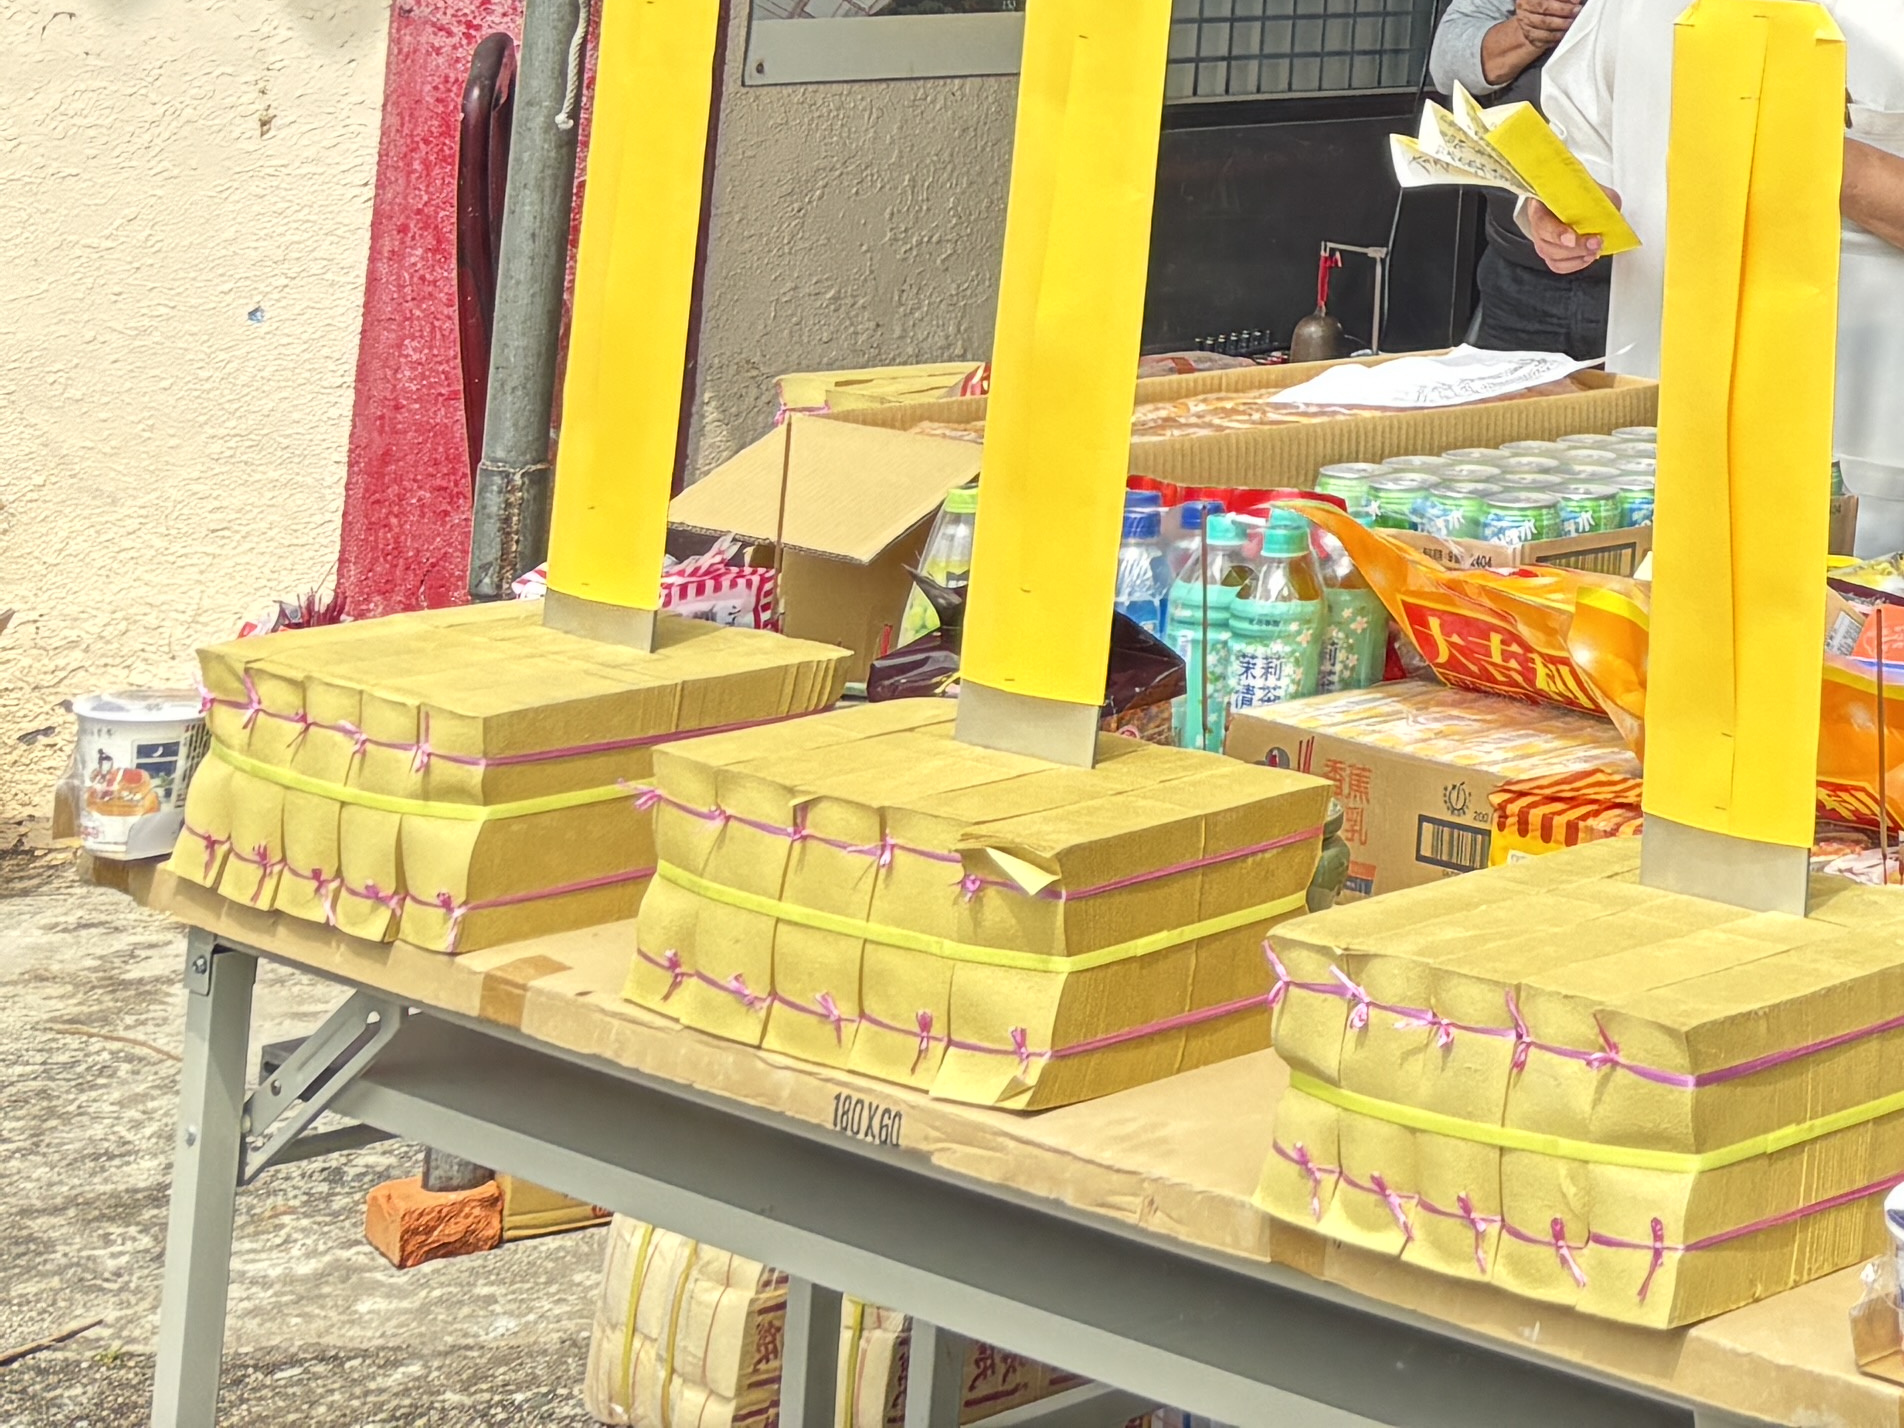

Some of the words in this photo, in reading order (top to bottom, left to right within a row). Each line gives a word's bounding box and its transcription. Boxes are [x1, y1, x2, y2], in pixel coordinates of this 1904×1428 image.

[1238, 652, 1286, 682] 茉莉
[1323, 758, 1373, 806] 香蕉
[832, 1091, 904, 1147] 180X60
